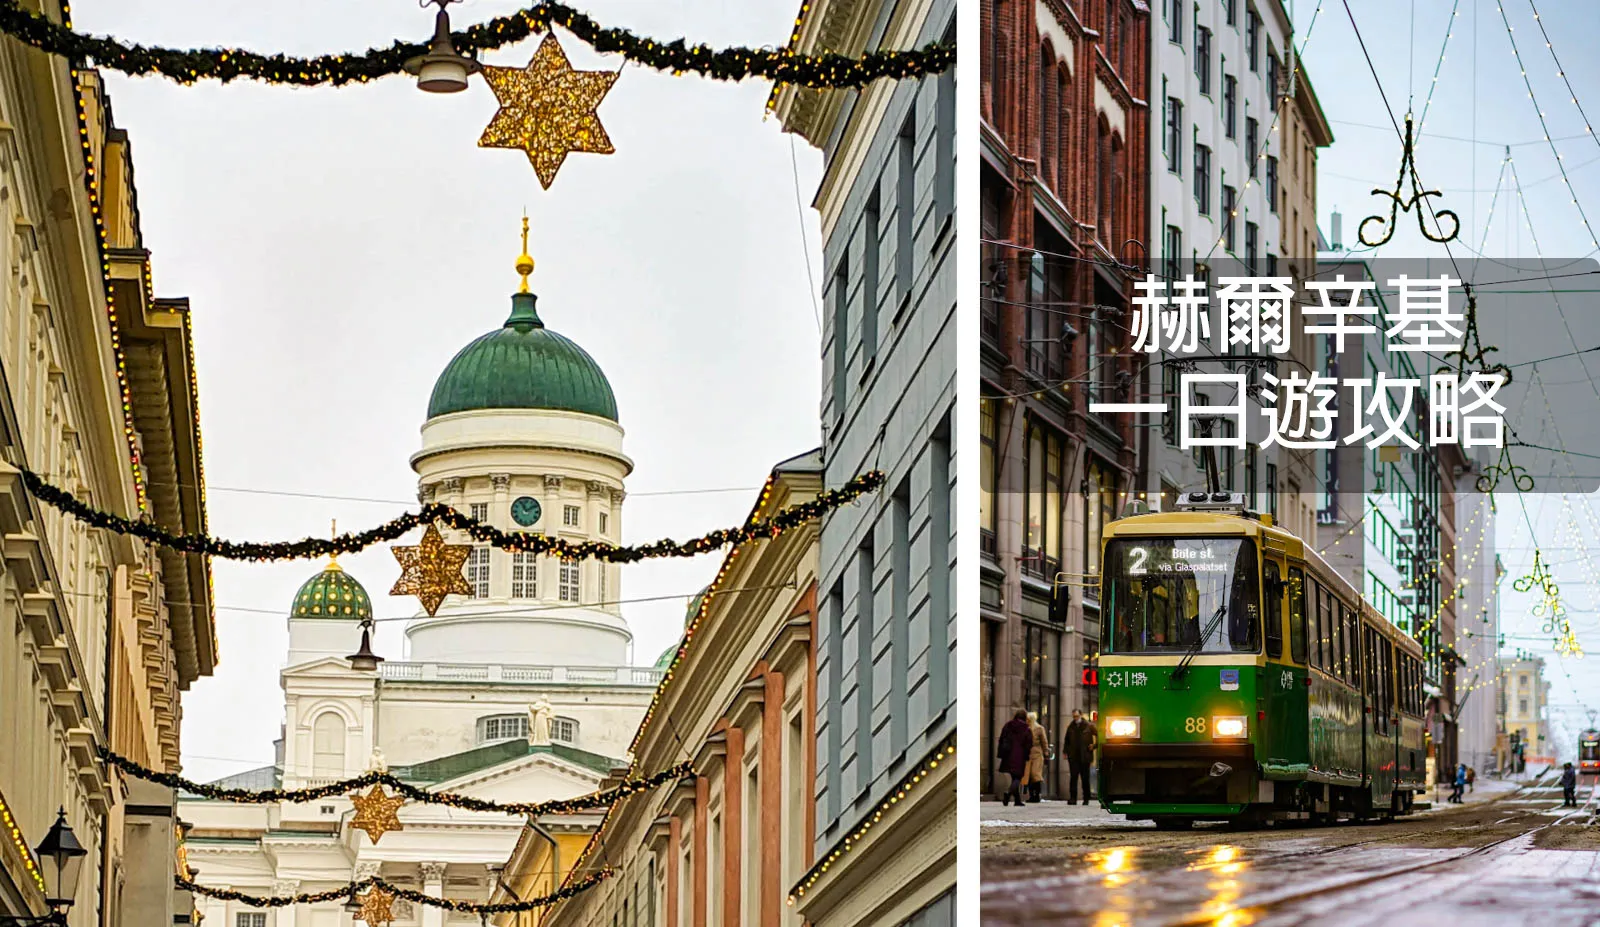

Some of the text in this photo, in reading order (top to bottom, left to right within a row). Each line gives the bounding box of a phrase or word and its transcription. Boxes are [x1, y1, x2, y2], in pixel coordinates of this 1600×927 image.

[1129, 547, 1148, 574] 2
[1158, 562, 1172, 572] via
[1132, 679, 1148, 687] HRT
[1185, 717, 1206, 733] 88
